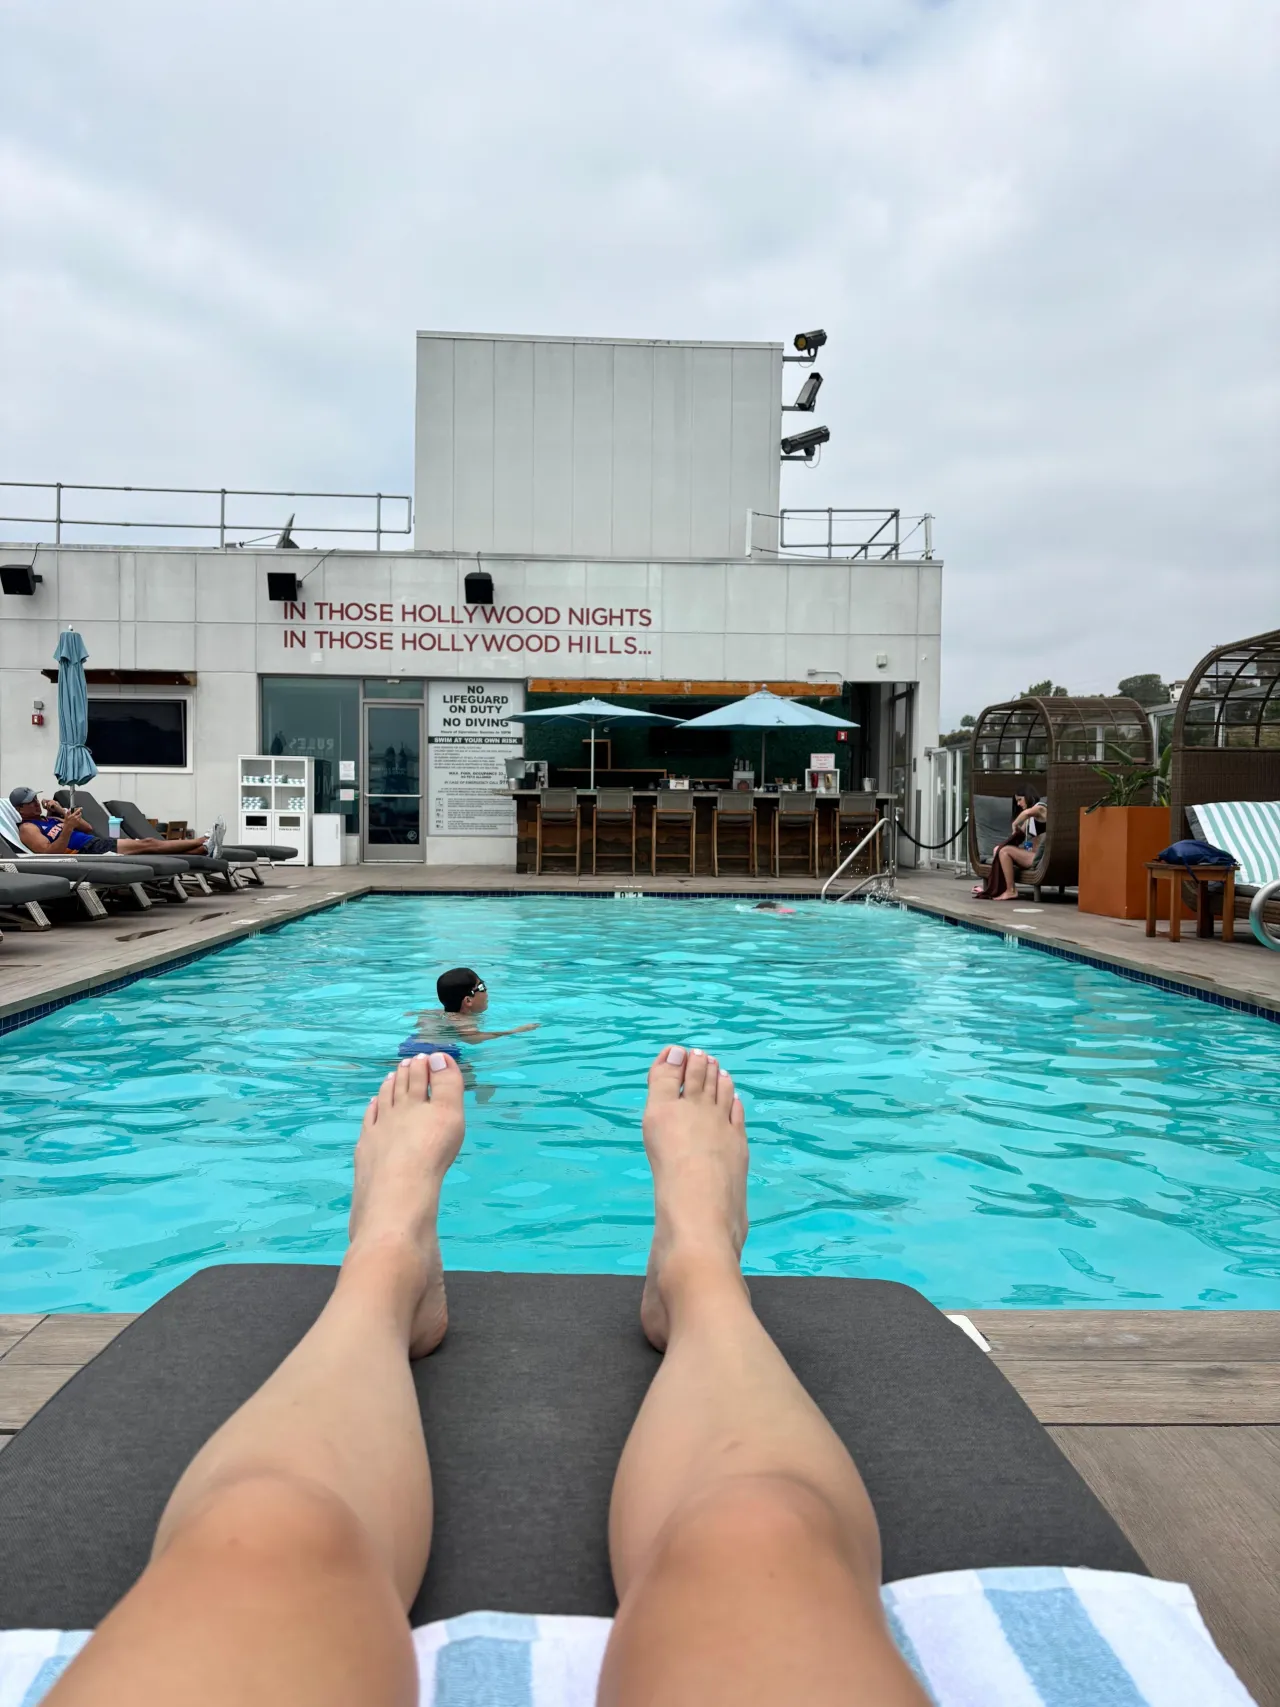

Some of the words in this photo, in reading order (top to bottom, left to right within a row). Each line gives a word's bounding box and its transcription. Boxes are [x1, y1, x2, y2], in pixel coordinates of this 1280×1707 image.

[283, 601, 306, 620] IN
[314, 602, 394, 622] THOSE
[401, 604, 561, 625] HOLLYWOOD
[568, 607, 652, 627] NIGHTS
[283, 630, 306, 649] IN
[314, 631, 394, 651] THOSE
[401, 632, 561, 653] HOLLYWOOD
[568, 635, 652, 655] HILLS...
[467, 685, 484, 694] NO
[443, 695, 509, 704] LIFEGUARD
[449, 705, 466, 713] ON
[470, 705, 502, 714] DUTY
[443, 718, 461, 727] NO
[465, 718, 509, 727] DIVING
